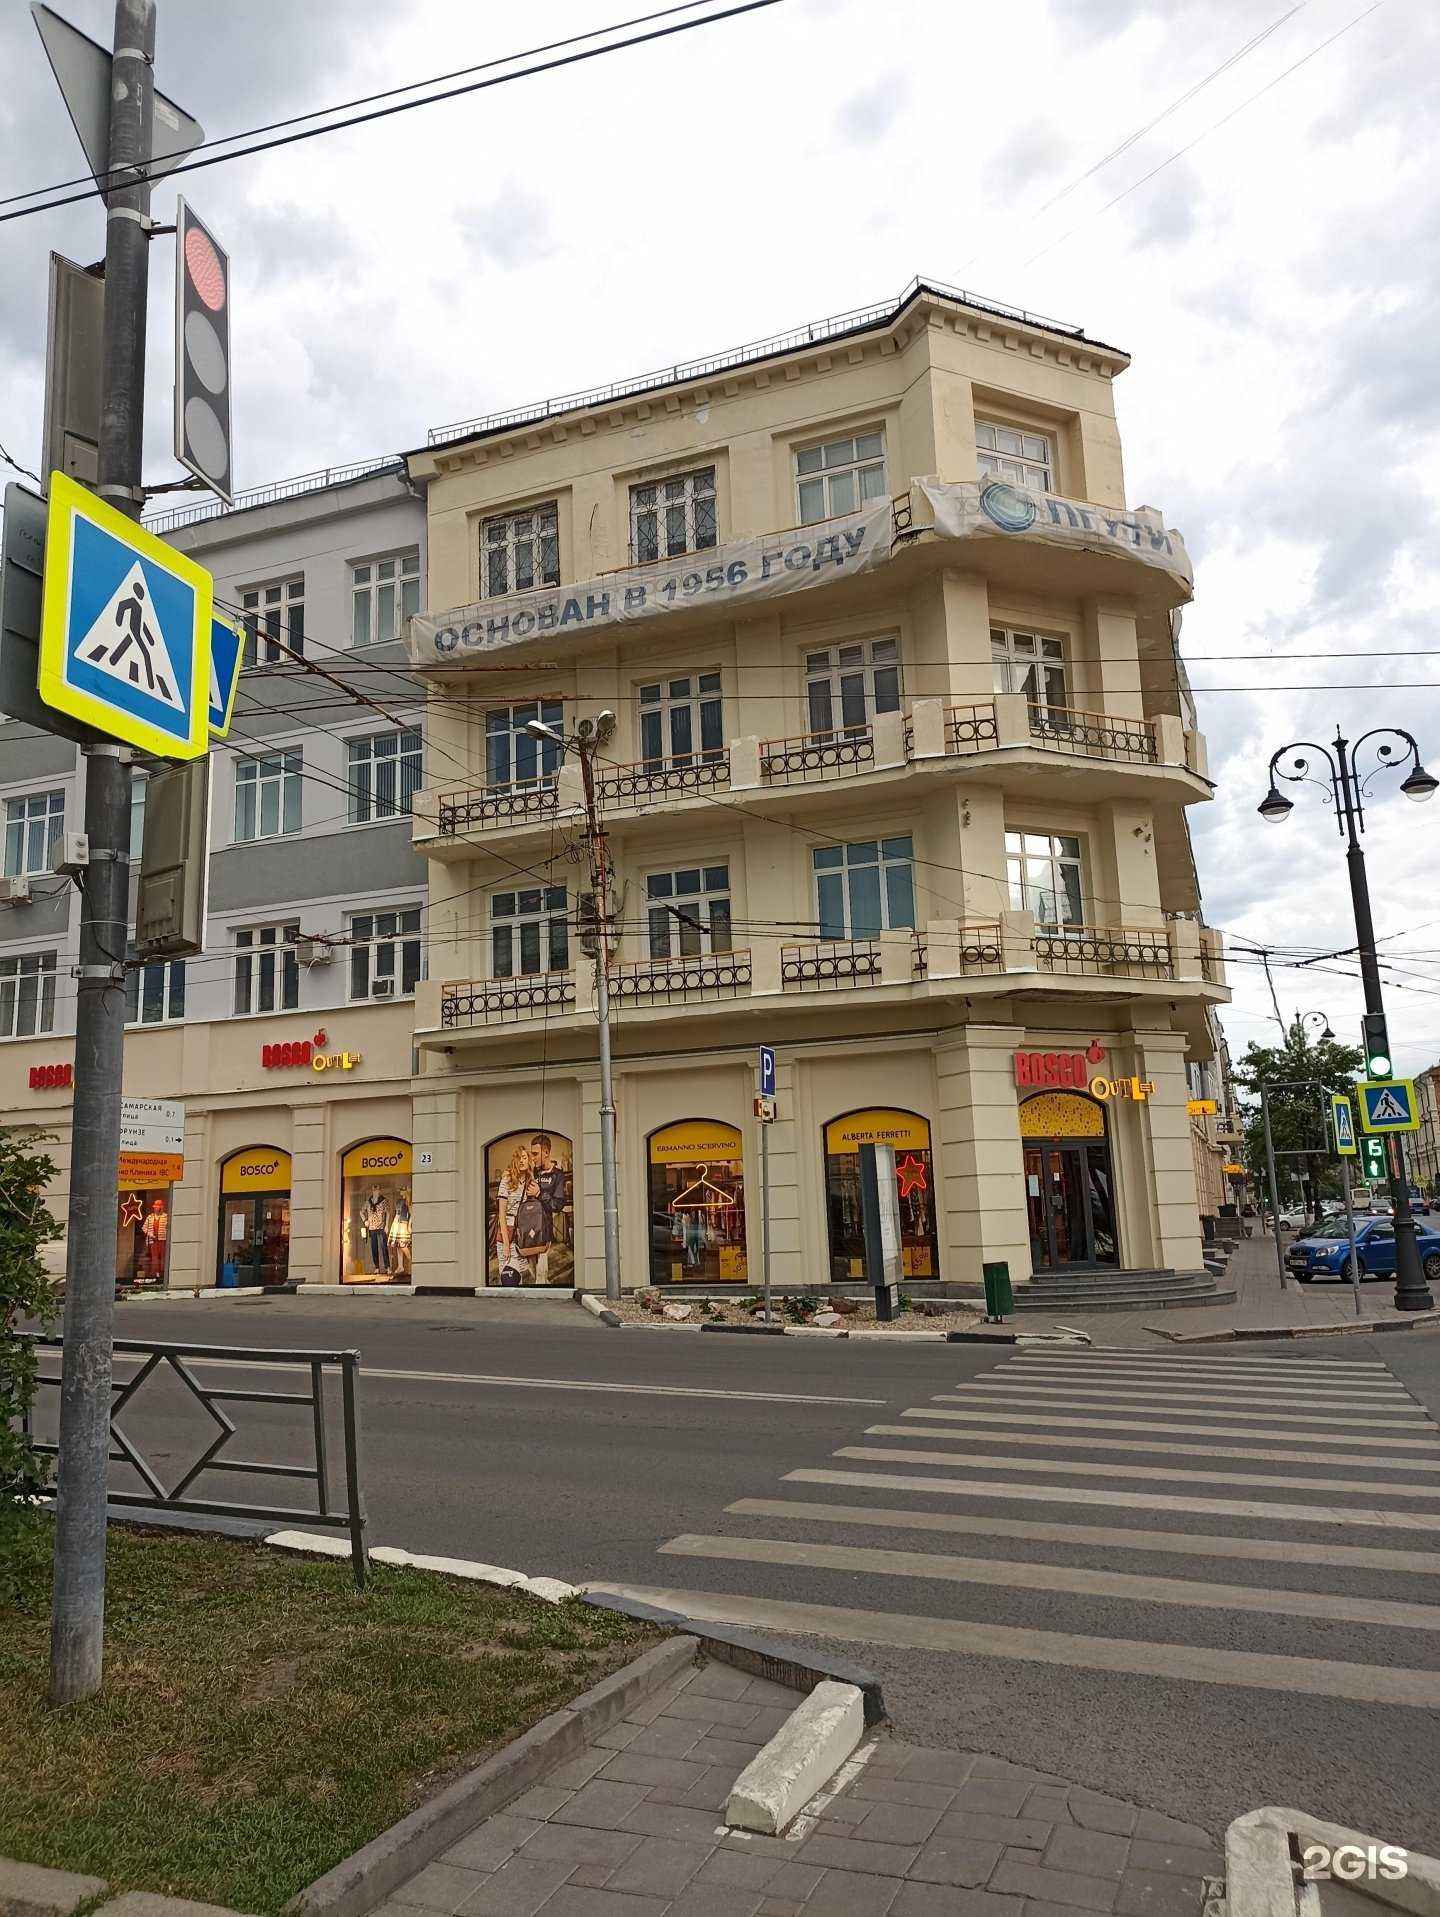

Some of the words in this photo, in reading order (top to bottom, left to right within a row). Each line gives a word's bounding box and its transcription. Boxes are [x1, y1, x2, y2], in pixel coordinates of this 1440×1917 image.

[1046, 499, 1173, 555] ПГУТИ
[434, 592, 610, 652] ОСНОВАН
[624, 585, 646, 609] В
[662, 561, 748, 602] 1956
[761, 526, 866, 581] ГОДУ
[262, 1041, 312, 1068] BOSCO
[763, 1053, 772, 1089] P
[1014, 1053, 1087, 1088] BOSCO
[841, 1132, 875, 1141] ALBERTA
[876, 1130, 912, 1139] FERRETTI
[656, 1144, 695, 1152] ERMANNO
[361, 1156, 398, 1168] BOSCO
[421, 1154, 432, 1163] 23
[240, 1165, 275, 1176] BOSCO
